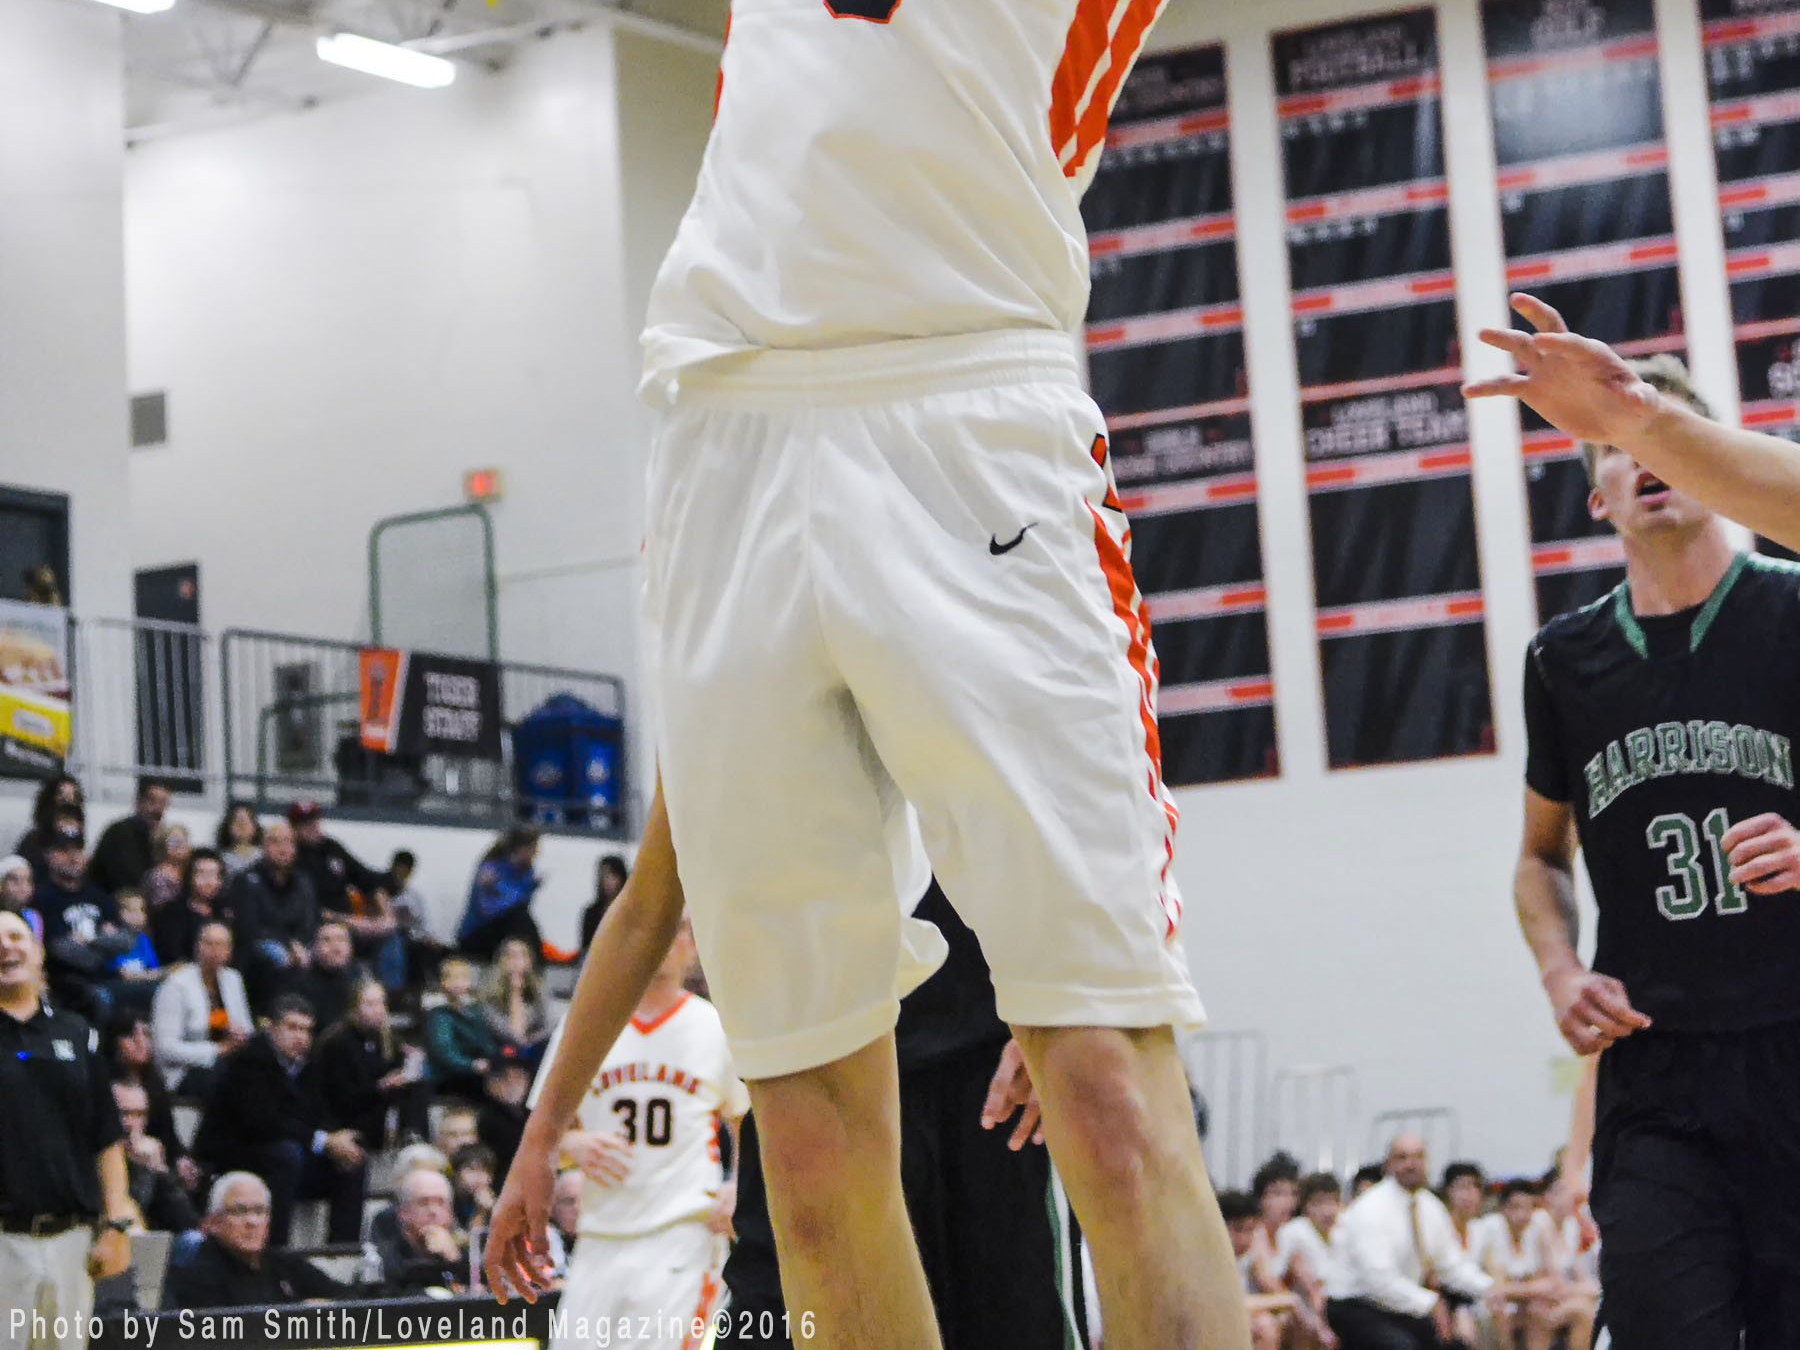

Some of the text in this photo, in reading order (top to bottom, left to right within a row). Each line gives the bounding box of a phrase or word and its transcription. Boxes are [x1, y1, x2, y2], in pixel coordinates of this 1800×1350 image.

[1584, 720, 1795, 819] HARRISON
[1646, 807, 1748, 921] 31
[612, 1098, 672, 1146] 30
